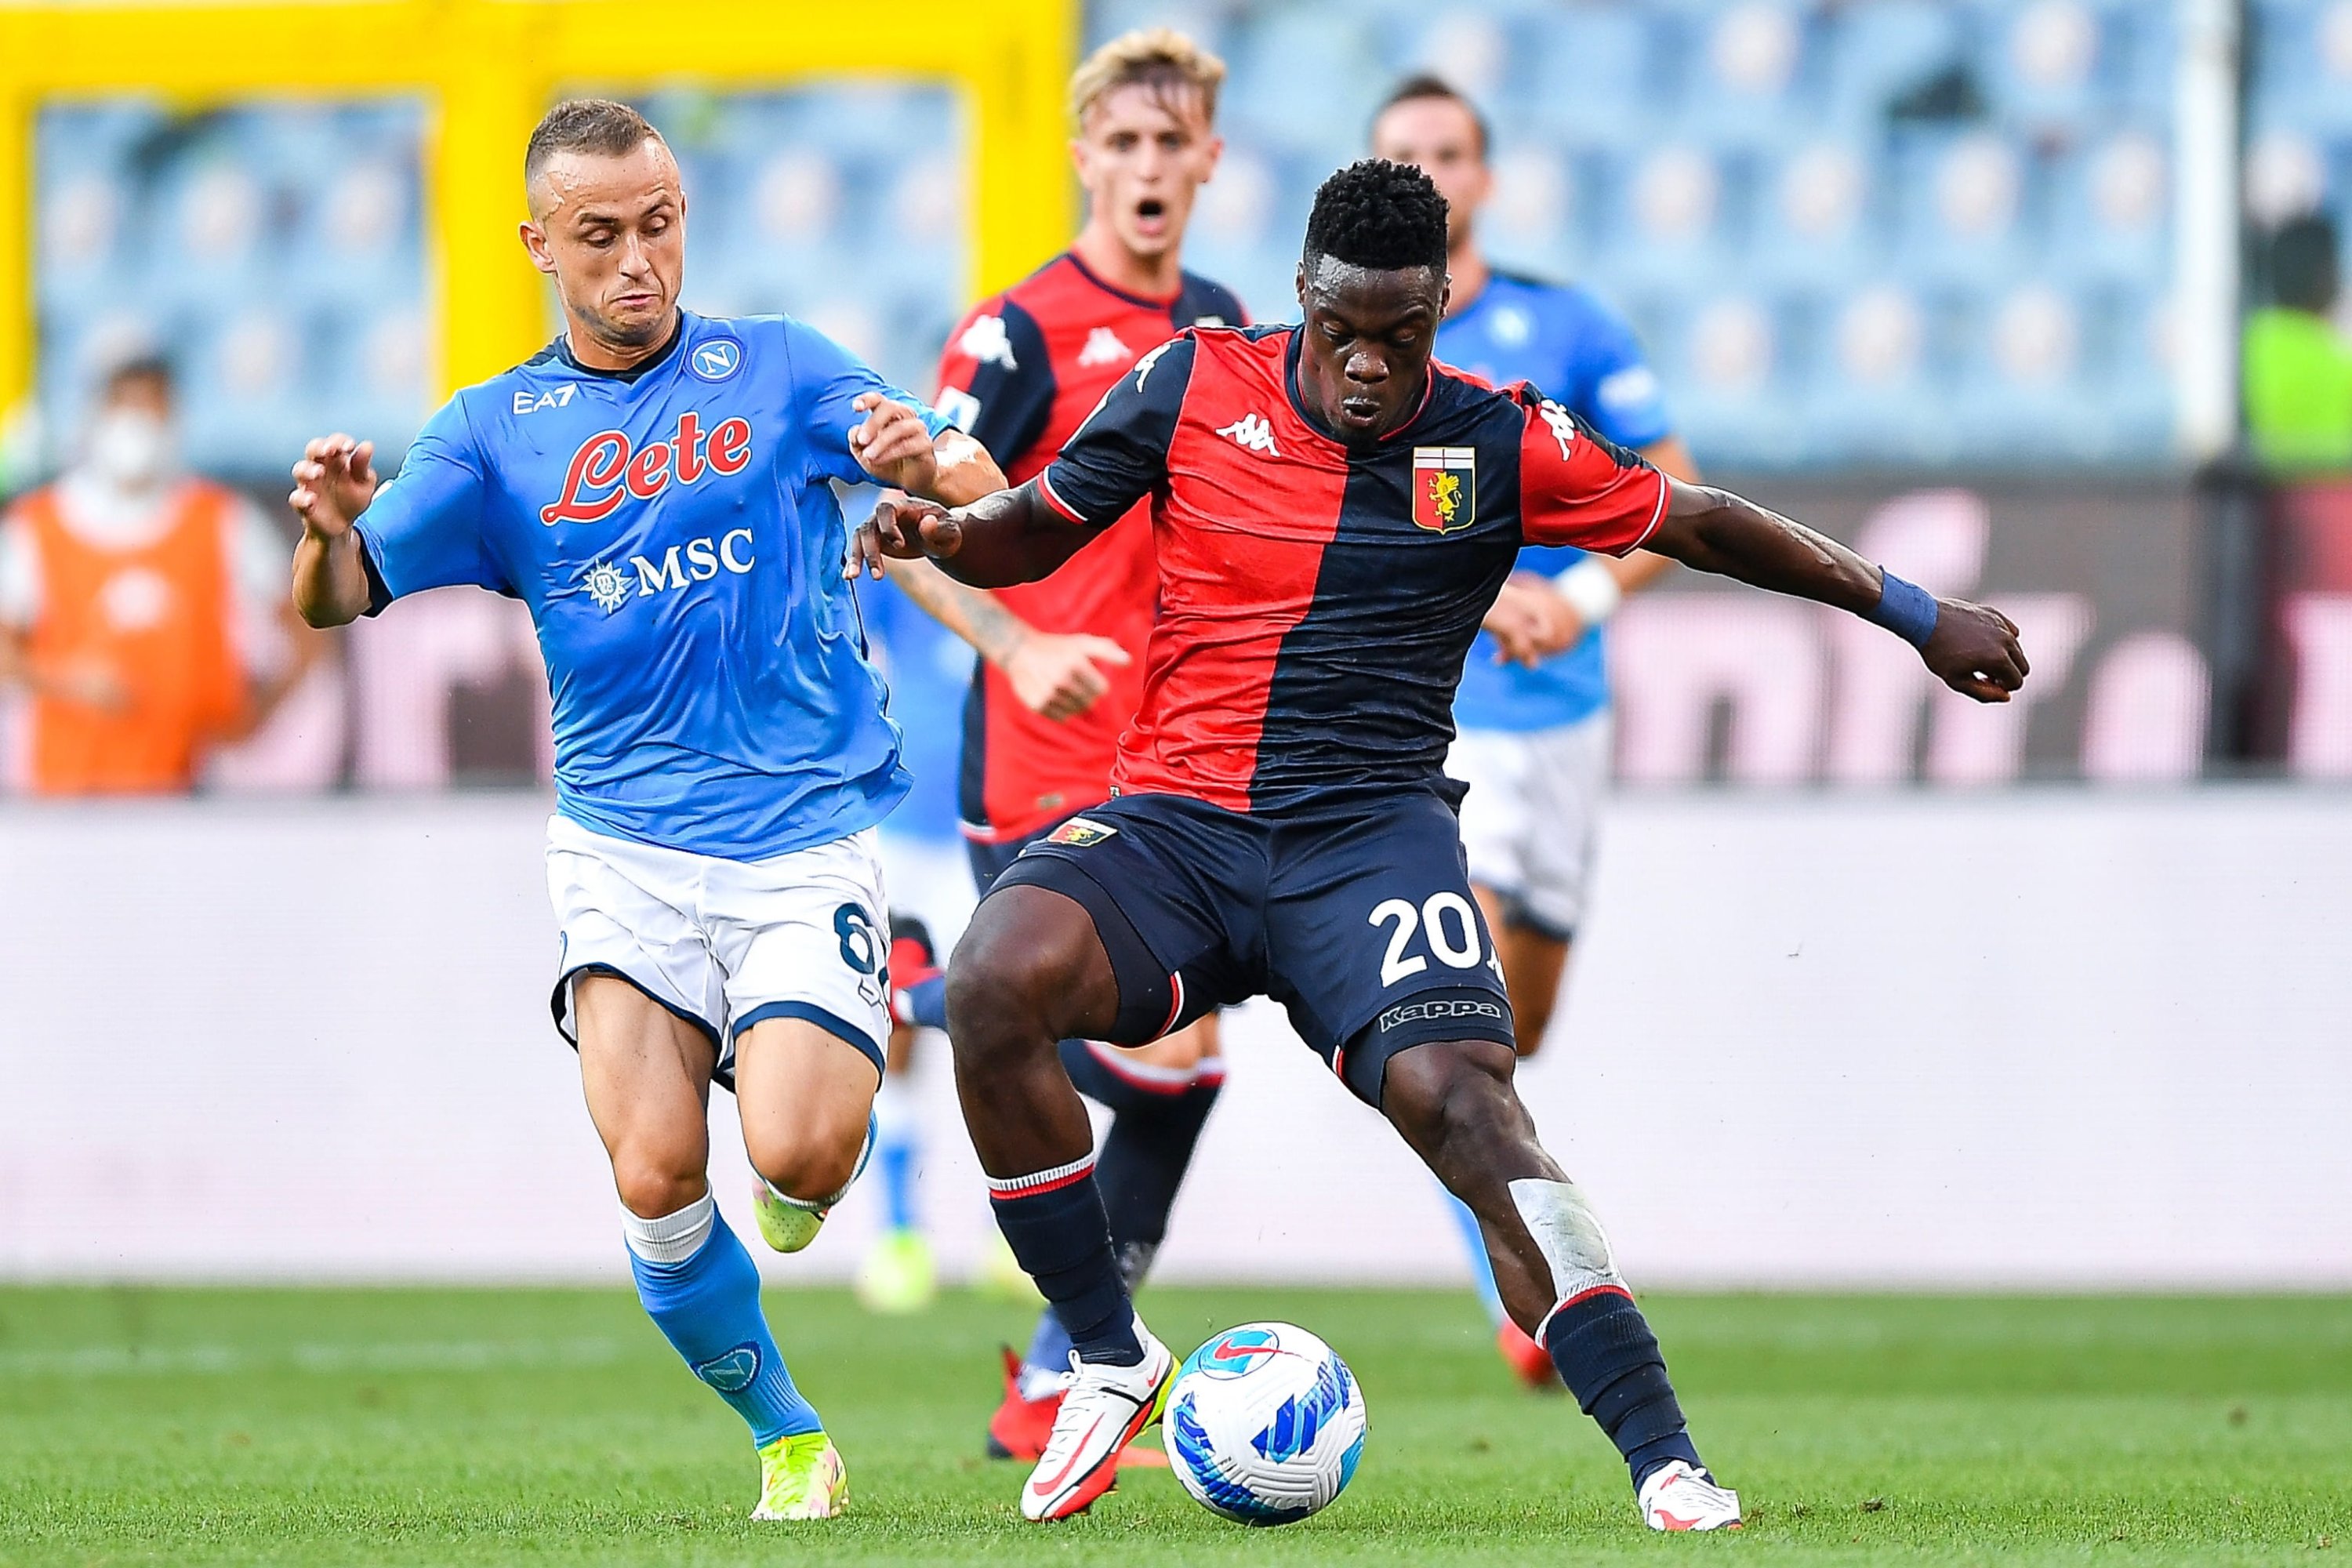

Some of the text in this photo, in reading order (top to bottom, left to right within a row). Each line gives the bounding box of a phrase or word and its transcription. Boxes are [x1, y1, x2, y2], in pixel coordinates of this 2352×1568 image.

[699, 345, 731, 374] N
[512, 382, 577, 415] EA7
[540, 412, 752, 524] Lete
[628, 527, 756, 597] MSC
[833, 902, 891, 987] 6
[1367, 891, 1483, 989] 20
[1378, 1000, 1501, 1033] Kappa
